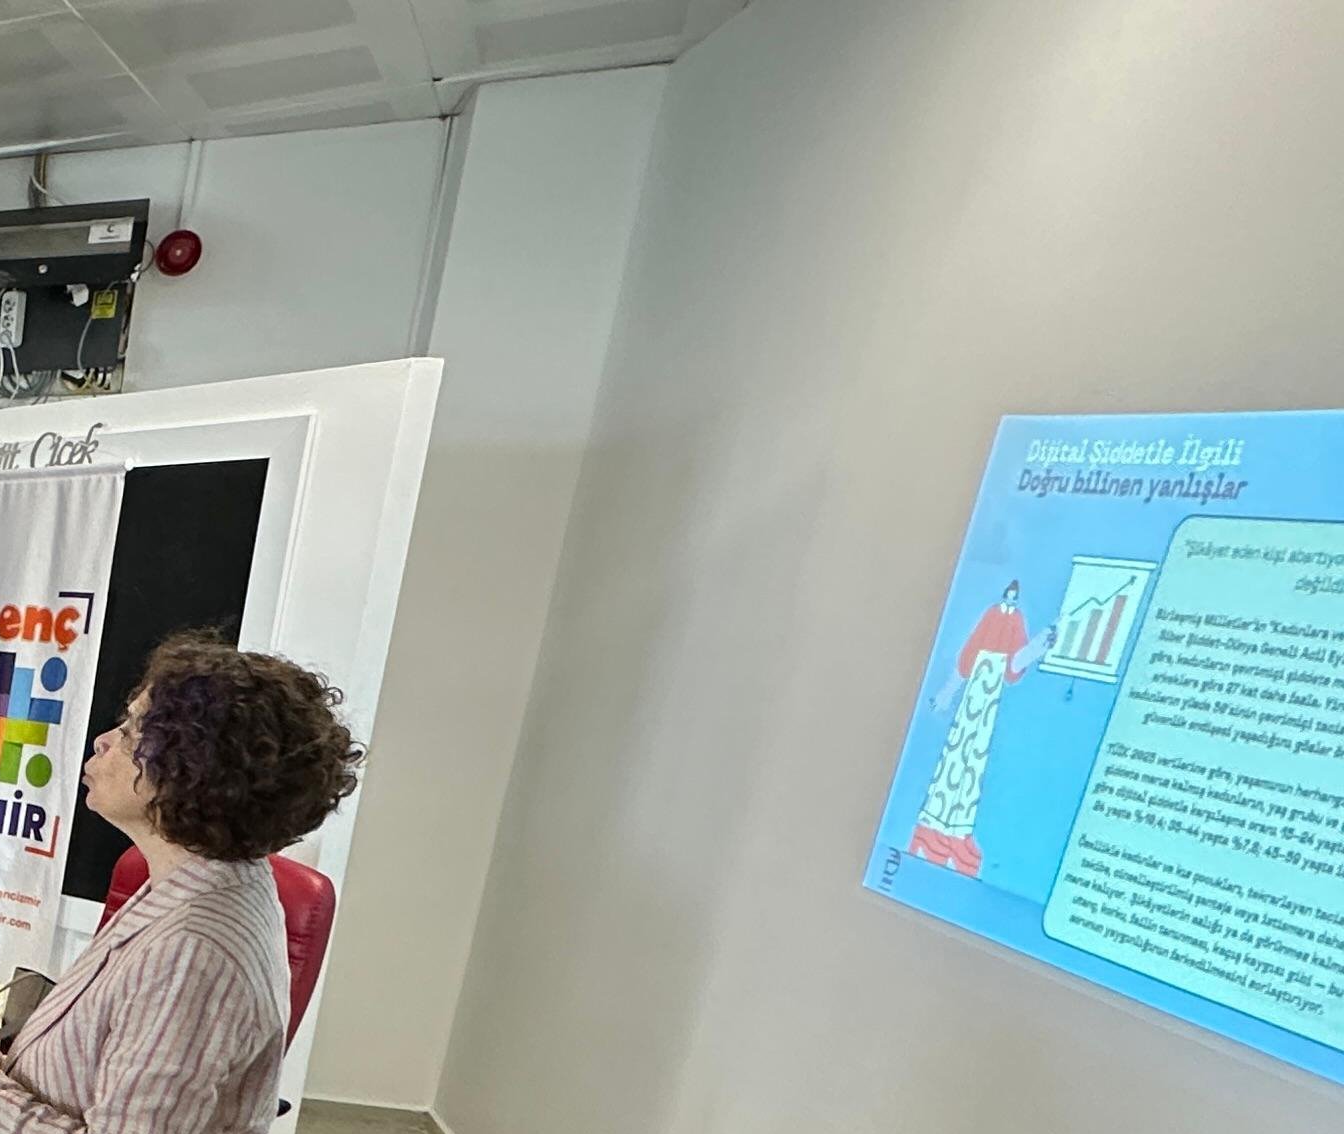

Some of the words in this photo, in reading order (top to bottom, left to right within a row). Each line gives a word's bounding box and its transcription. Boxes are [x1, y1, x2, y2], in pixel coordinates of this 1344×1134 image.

[1026, 439, 1088, 467] Dijital
[1089, 439, 1174, 468] Şiddetle
[1177, 434, 1245, 471] İlgili
[1018, 468, 1070, 497] Doğru
[1072, 470, 1143, 496] bilinen
[1144, 472, 1248, 505] yanlışlar
